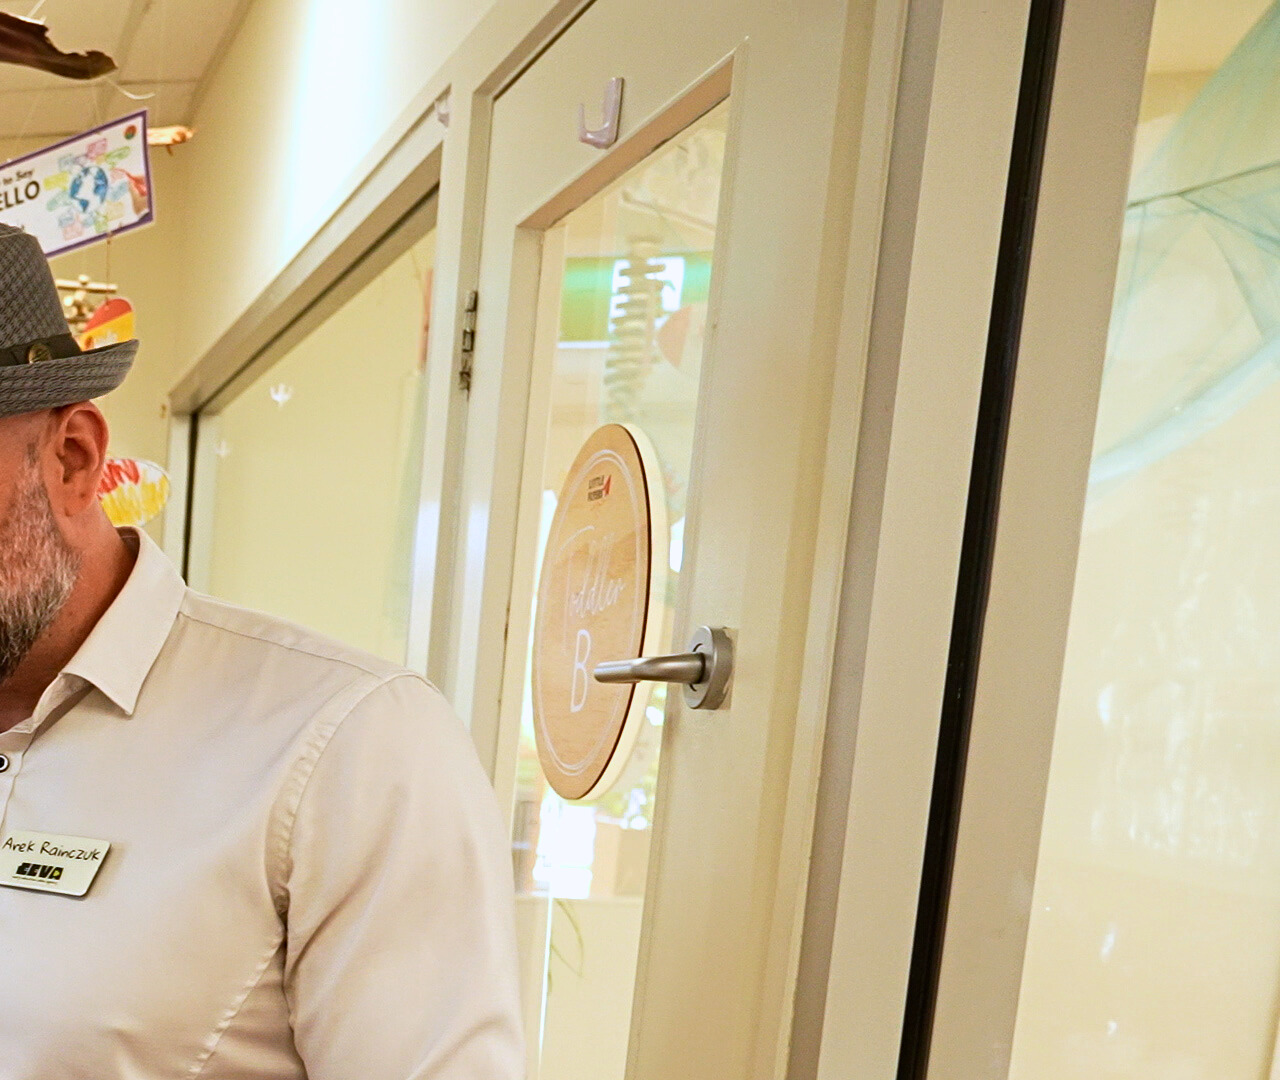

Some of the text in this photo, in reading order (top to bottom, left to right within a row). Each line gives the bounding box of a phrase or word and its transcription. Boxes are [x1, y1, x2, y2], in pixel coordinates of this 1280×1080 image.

[552, 525, 627, 656] Toddler
[571, 629, 591, 713] B
[2, 837, 36, 853] Arek
